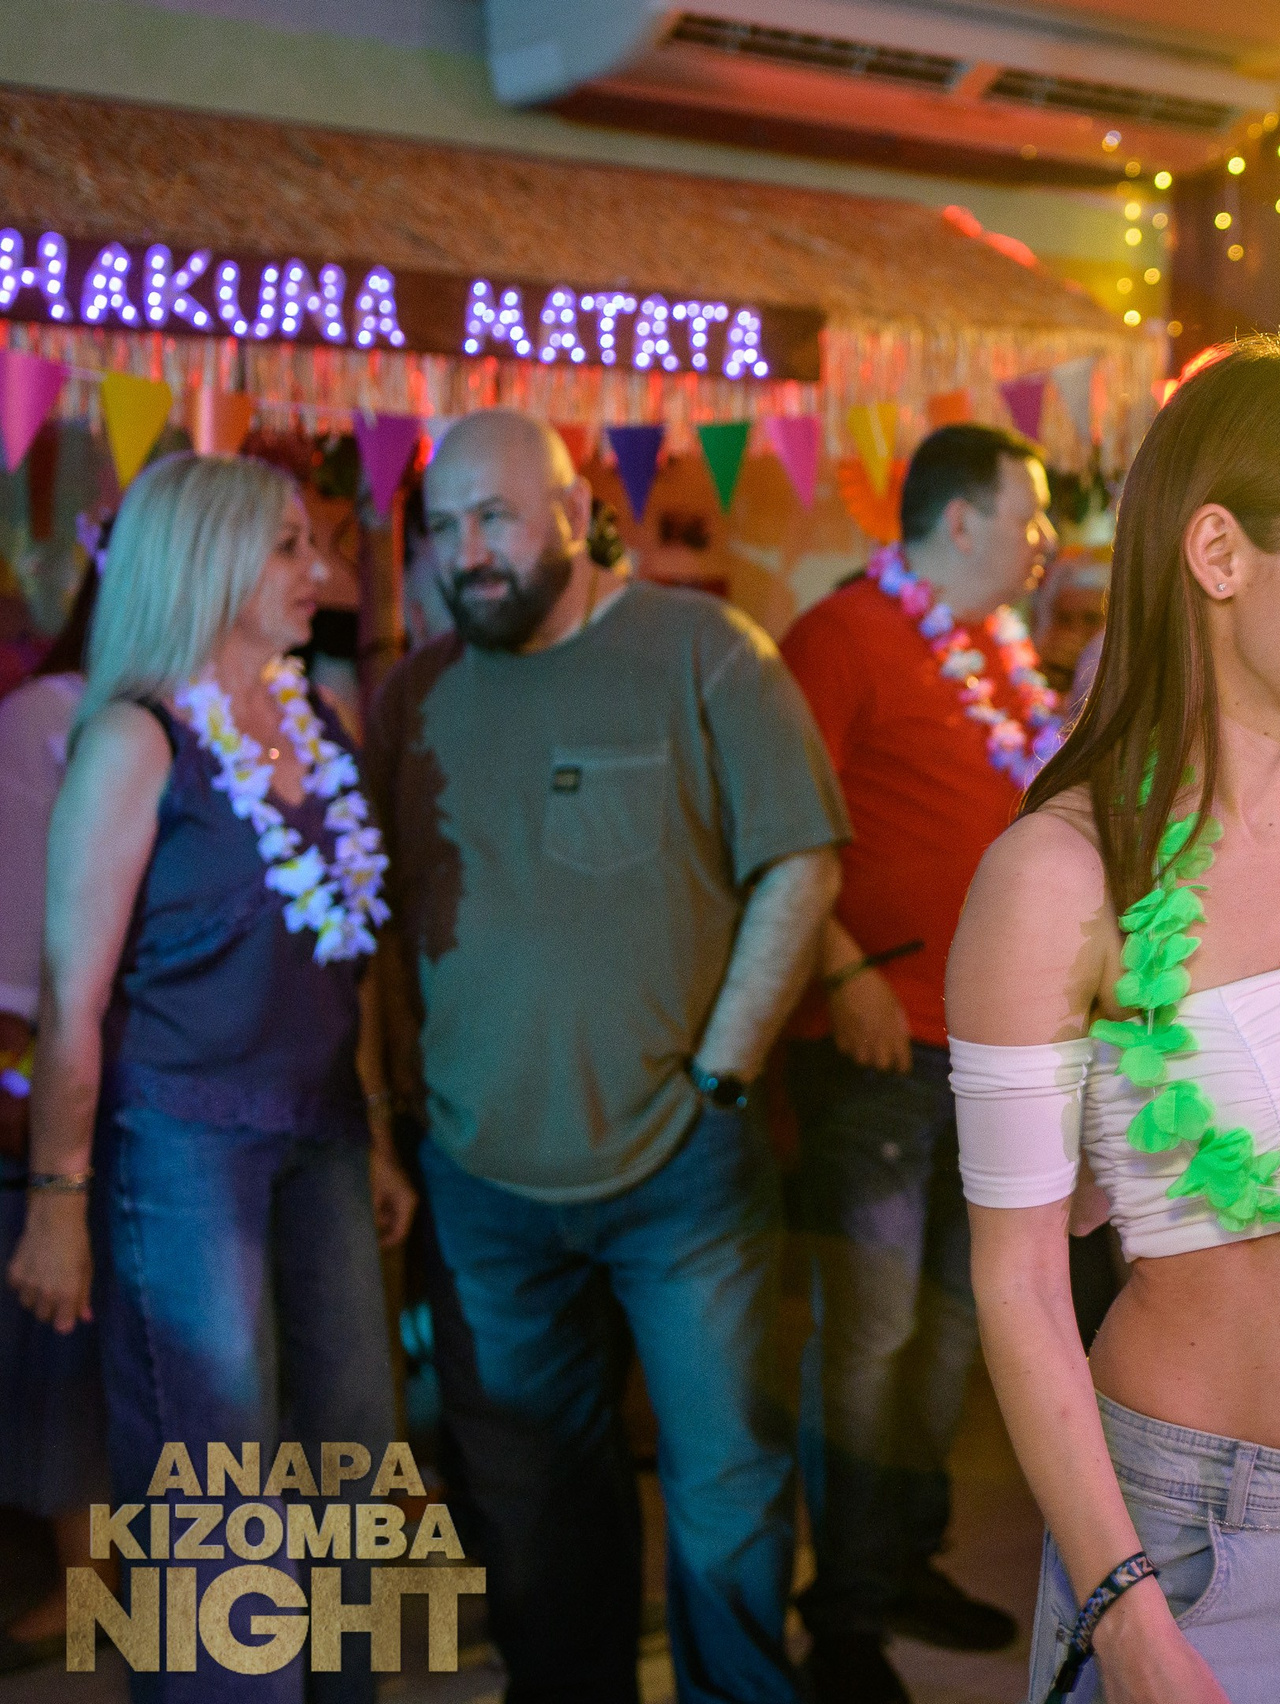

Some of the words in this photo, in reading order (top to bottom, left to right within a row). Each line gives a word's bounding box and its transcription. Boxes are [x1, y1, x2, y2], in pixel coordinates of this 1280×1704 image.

[0, 227, 406, 349] HAKUNA
[463, 279, 769, 380] MATATA
[1113, 1555, 1156, 1588] KIZ
